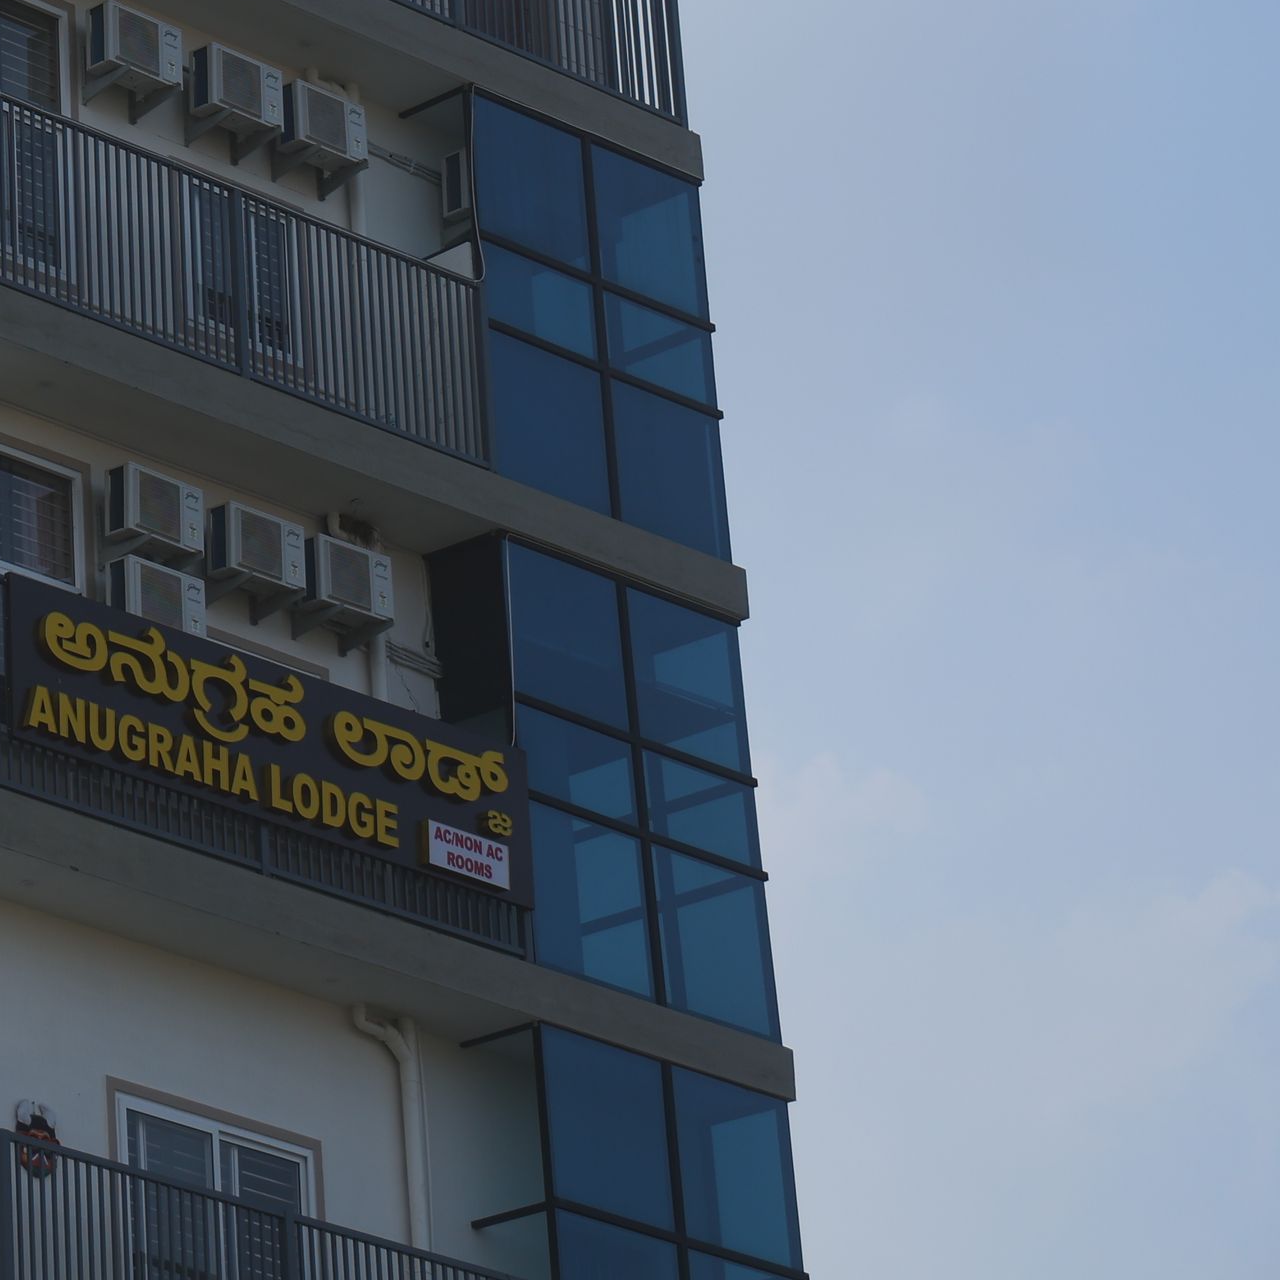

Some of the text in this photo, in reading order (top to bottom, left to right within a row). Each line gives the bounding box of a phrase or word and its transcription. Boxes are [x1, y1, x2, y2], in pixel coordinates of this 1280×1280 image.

[45, 611, 307, 743] ಅನುಗ್ರಹ
[28, 685, 399, 848] ANUGRAHA LODGE
[434, 826, 503, 862] AC/NON AC
[446, 850, 493, 880] ROOMS
